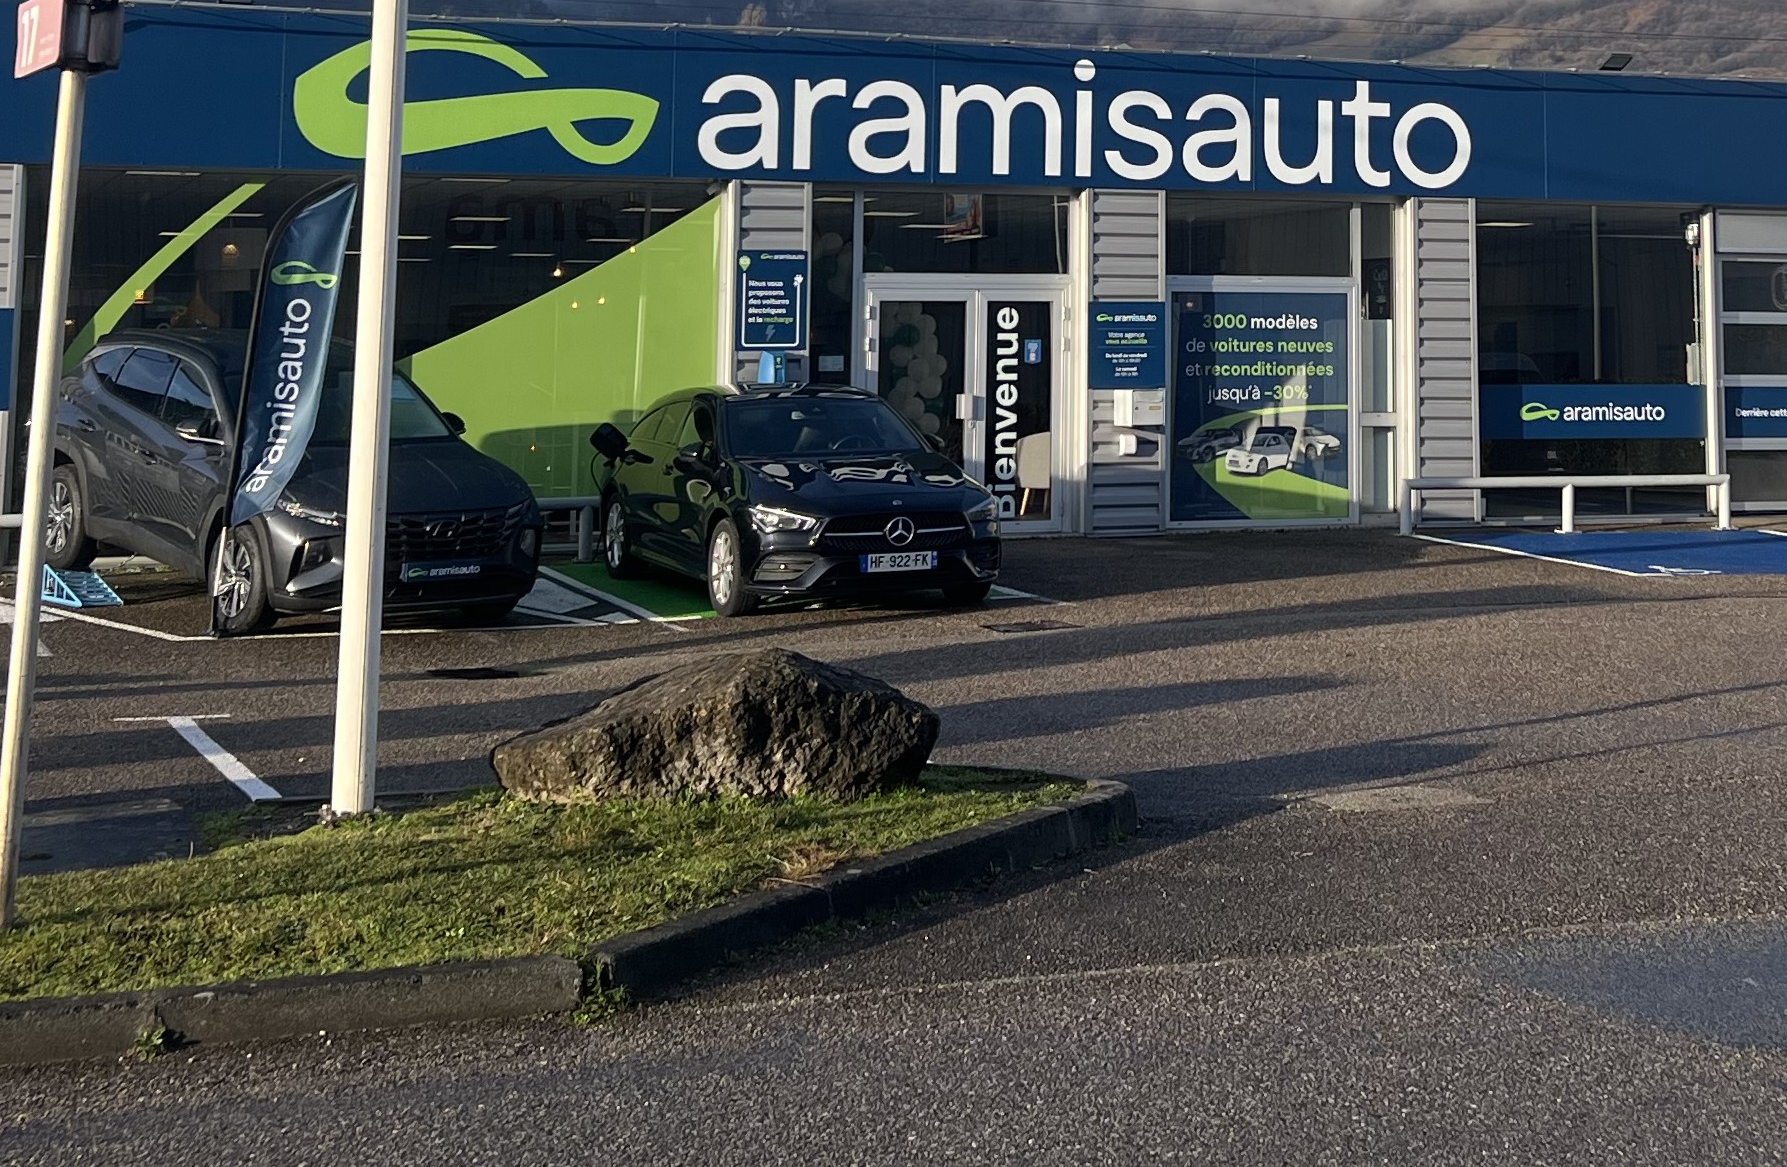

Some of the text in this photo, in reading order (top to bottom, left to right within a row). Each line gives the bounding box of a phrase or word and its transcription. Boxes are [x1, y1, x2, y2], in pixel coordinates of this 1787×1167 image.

[697, 59, 1473, 189] aramisauto
[1203, 314, 1318, 330] 3000 modèles
[1186, 338, 1334, 353] de voitures neuves
[1186, 361, 1334, 377] et reconditionnées
[246, 298, 312, 493] aramisauto
[986, 306, 1019, 519] Bienvenue
[1563, 402, 1666, 422] aramisauto
[1735, 407, 1769, 417] Derrière
[429, 565, 481, 576] aramisauto
